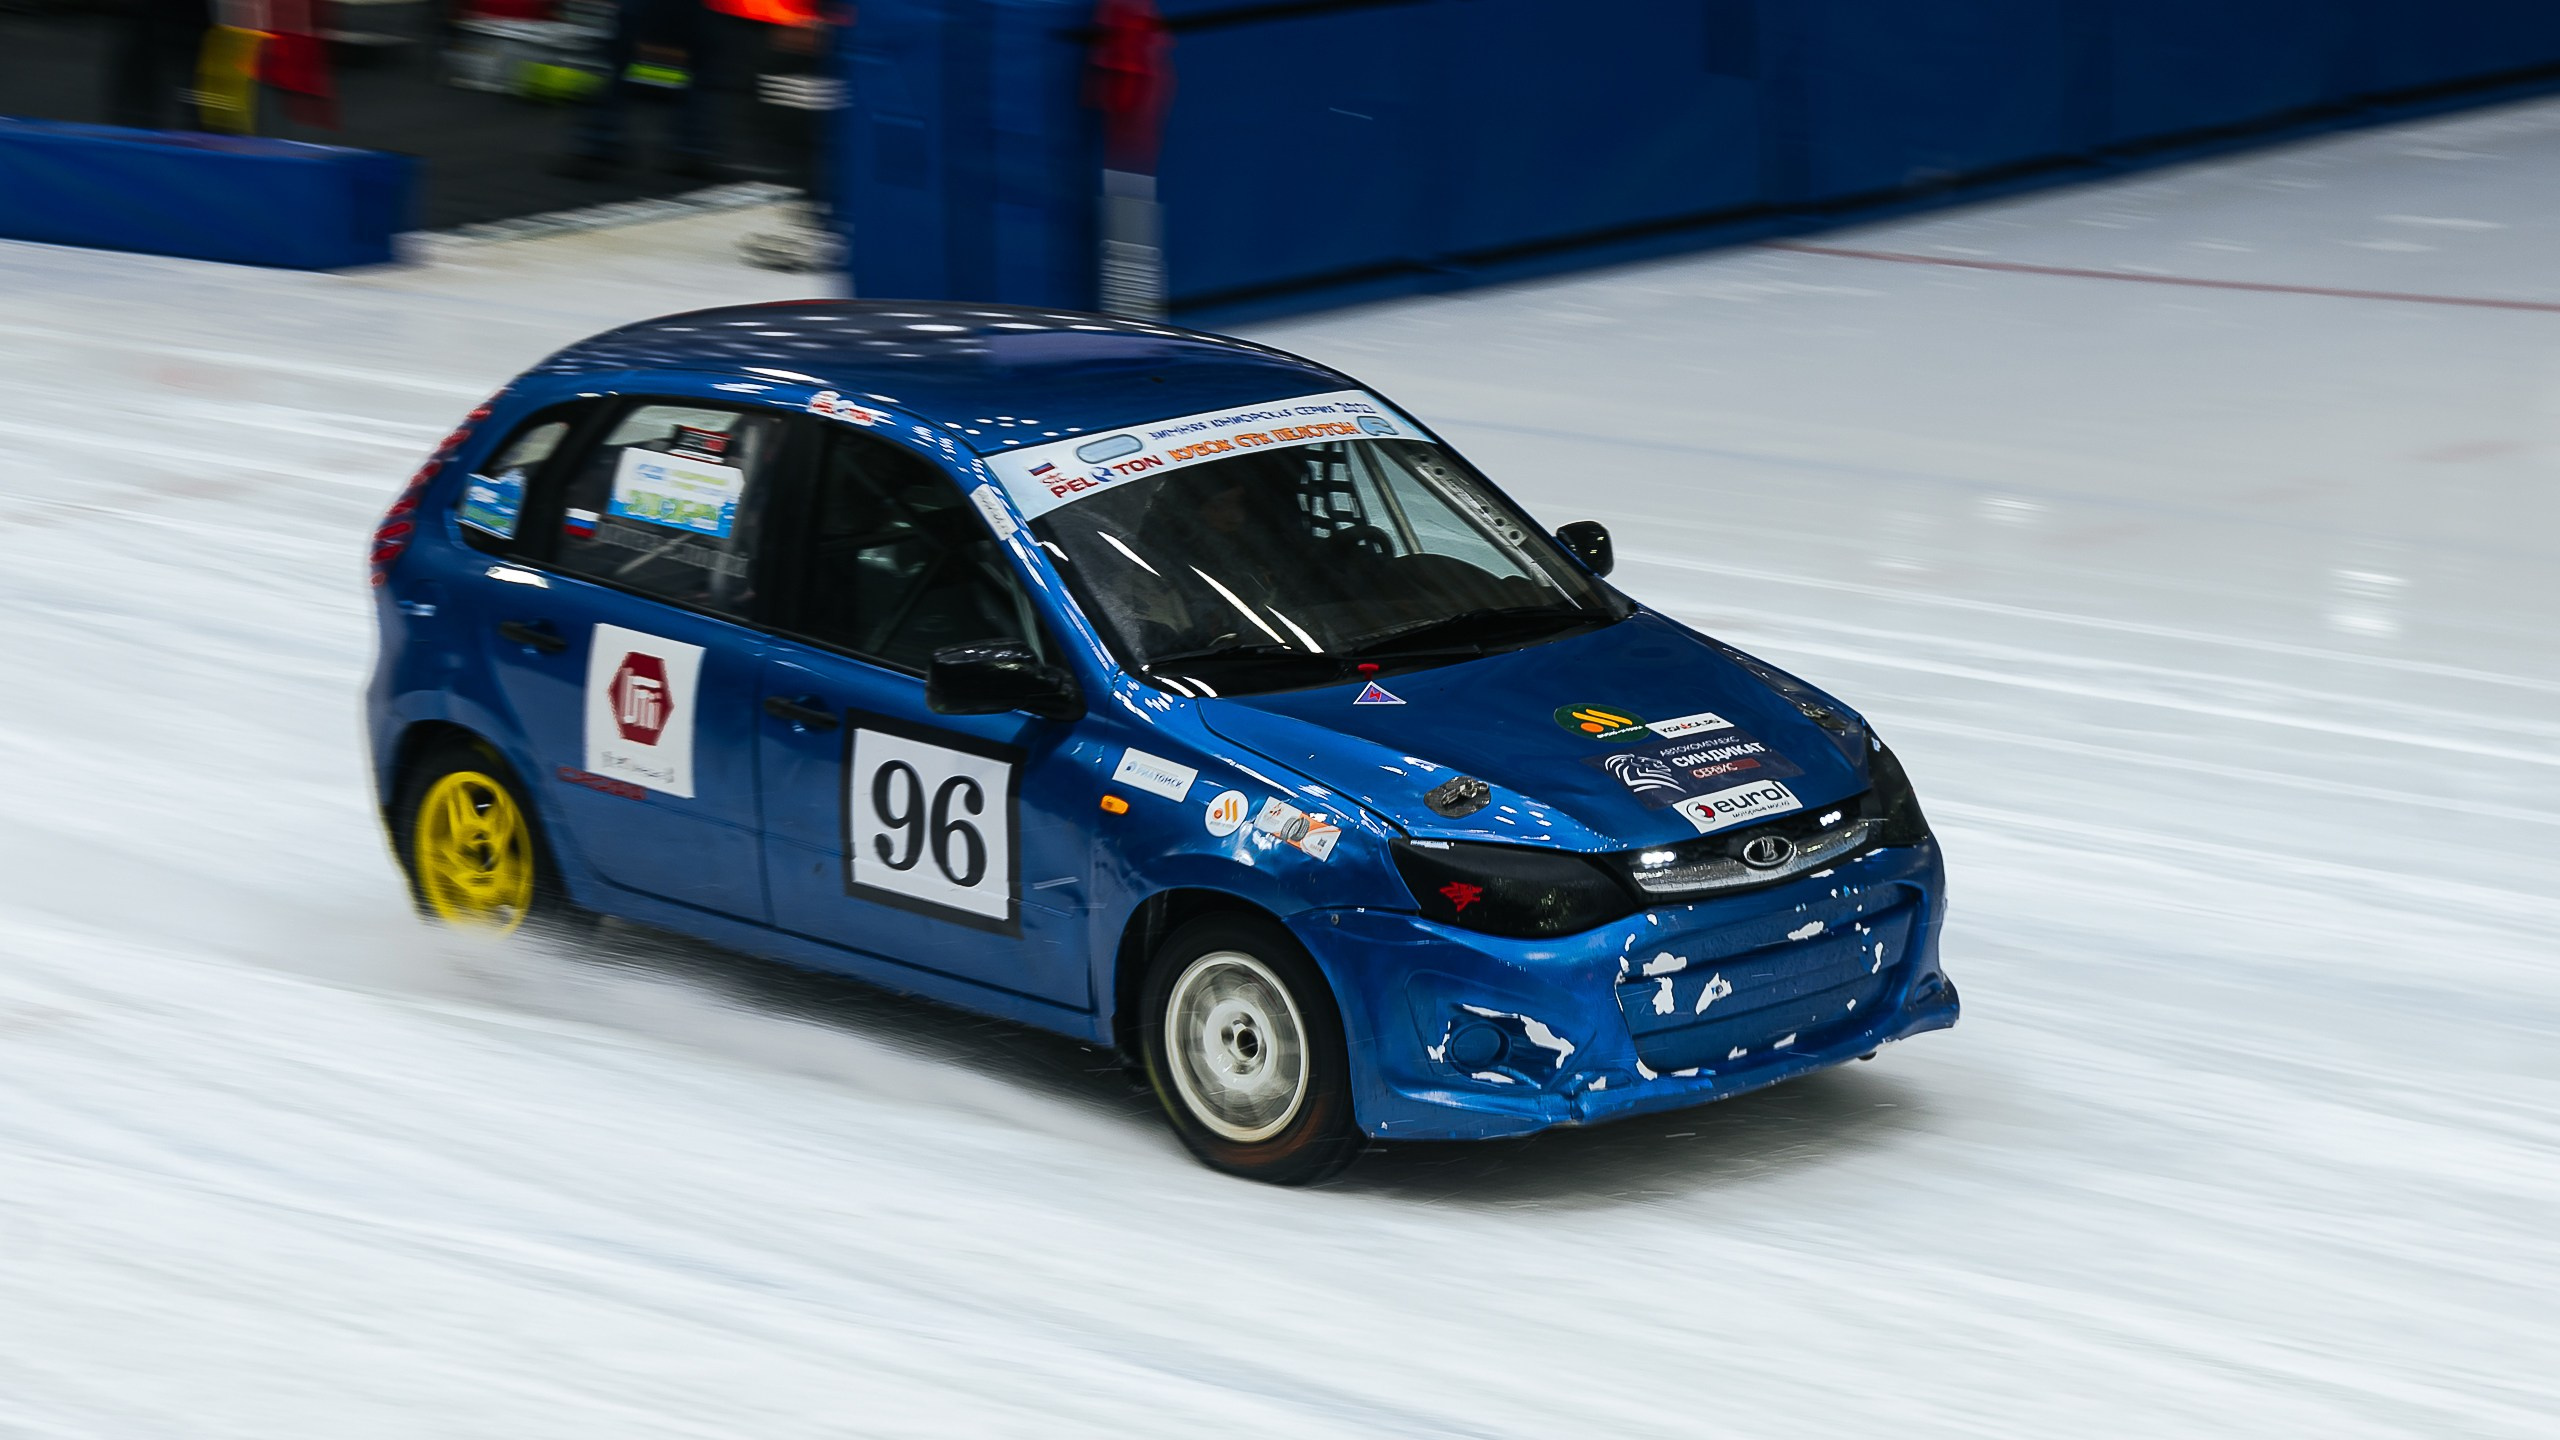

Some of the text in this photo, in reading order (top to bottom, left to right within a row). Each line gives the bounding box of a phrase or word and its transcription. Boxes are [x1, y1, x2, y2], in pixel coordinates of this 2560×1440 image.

[1234, 431, 1275, 447] СТК
[1270, 421, 1361, 441] ПЕЛОТОН
[1672, 742, 1765, 767] СИНДИКАТ
[1692, 762, 1738, 778] СЕРВИС
[1713, 781, 1790, 813] eurol
[872, 759, 988, 888] 96
